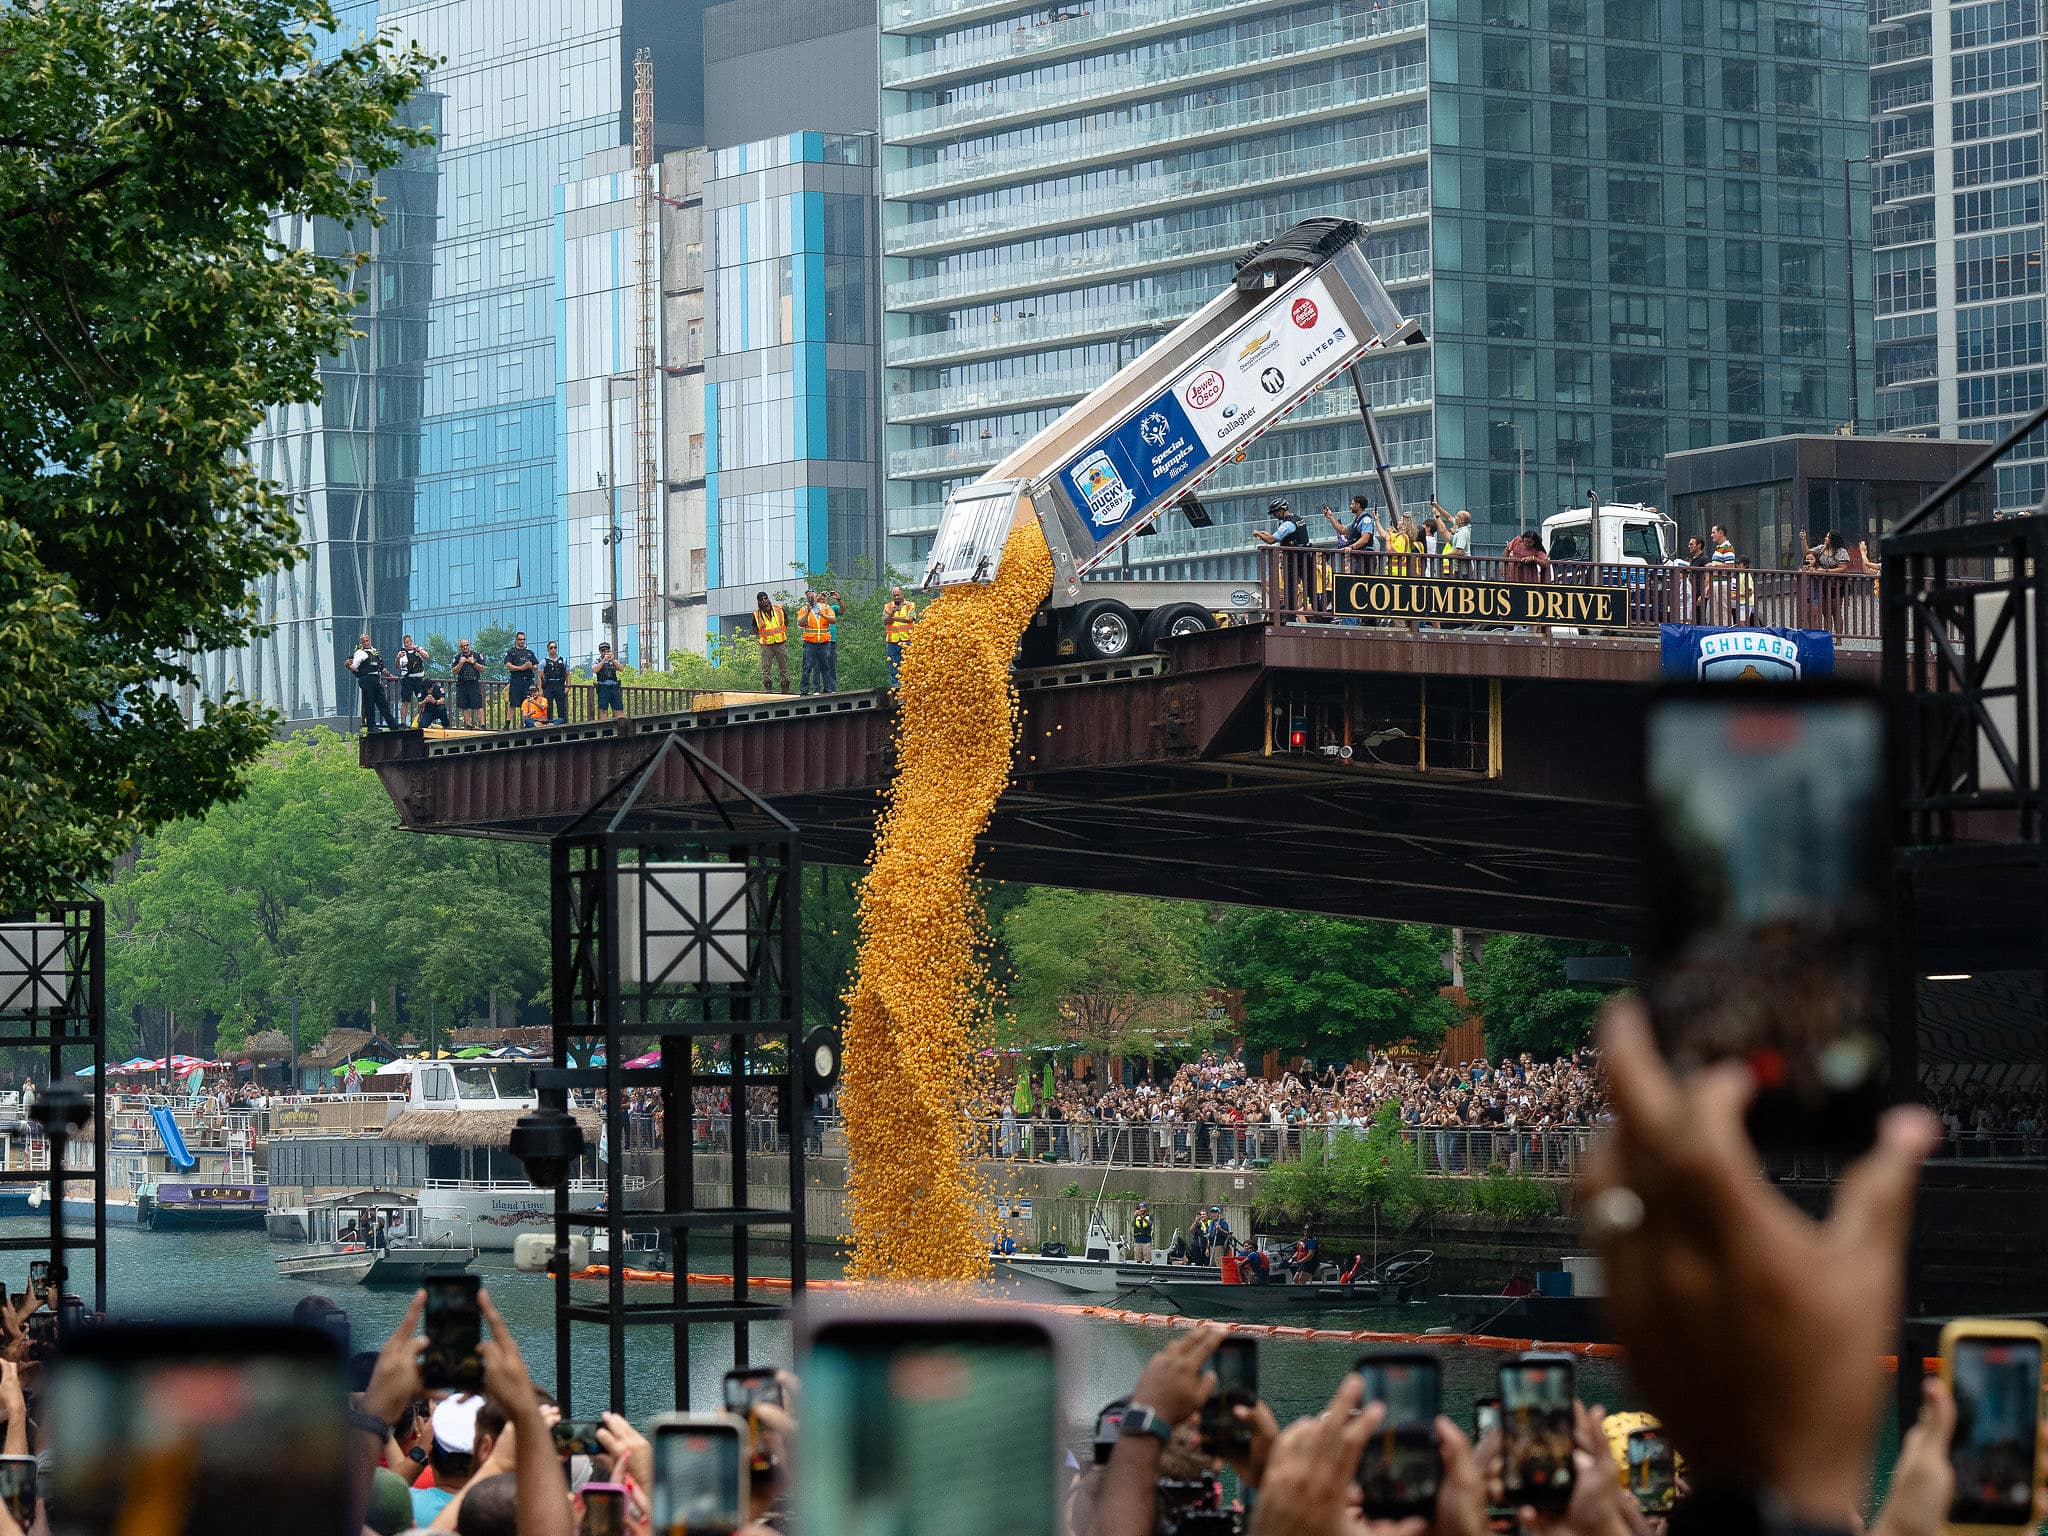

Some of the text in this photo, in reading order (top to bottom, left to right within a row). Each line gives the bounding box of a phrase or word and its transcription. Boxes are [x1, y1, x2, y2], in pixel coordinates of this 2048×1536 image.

[1300, 338, 1334, 366] UNITED
[1192, 374, 1215, 399] Jewel
[1197, 385, 1219, 405] Osco
[1217, 406, 1256, 438] Gallagher
[1151, 437, 1184, 466] Special
[1153, 444, 1193, 478] Olympics
[1169, 461, 1188, 478] Illinois
[1091, 482, 1123, 512] DUCKY
[1101, 496, 1123, 515] DERBY
[1349, 582, 1613, 621] COLUMBUS DRIVE
[1705, 637, 1794, 660] CHICAGO
[200, 1188, 243, 1198] KONA
[492, 1200, 544, 1210] Island Time
[1030, 1265, 1103, 1276] Chicago Park District
